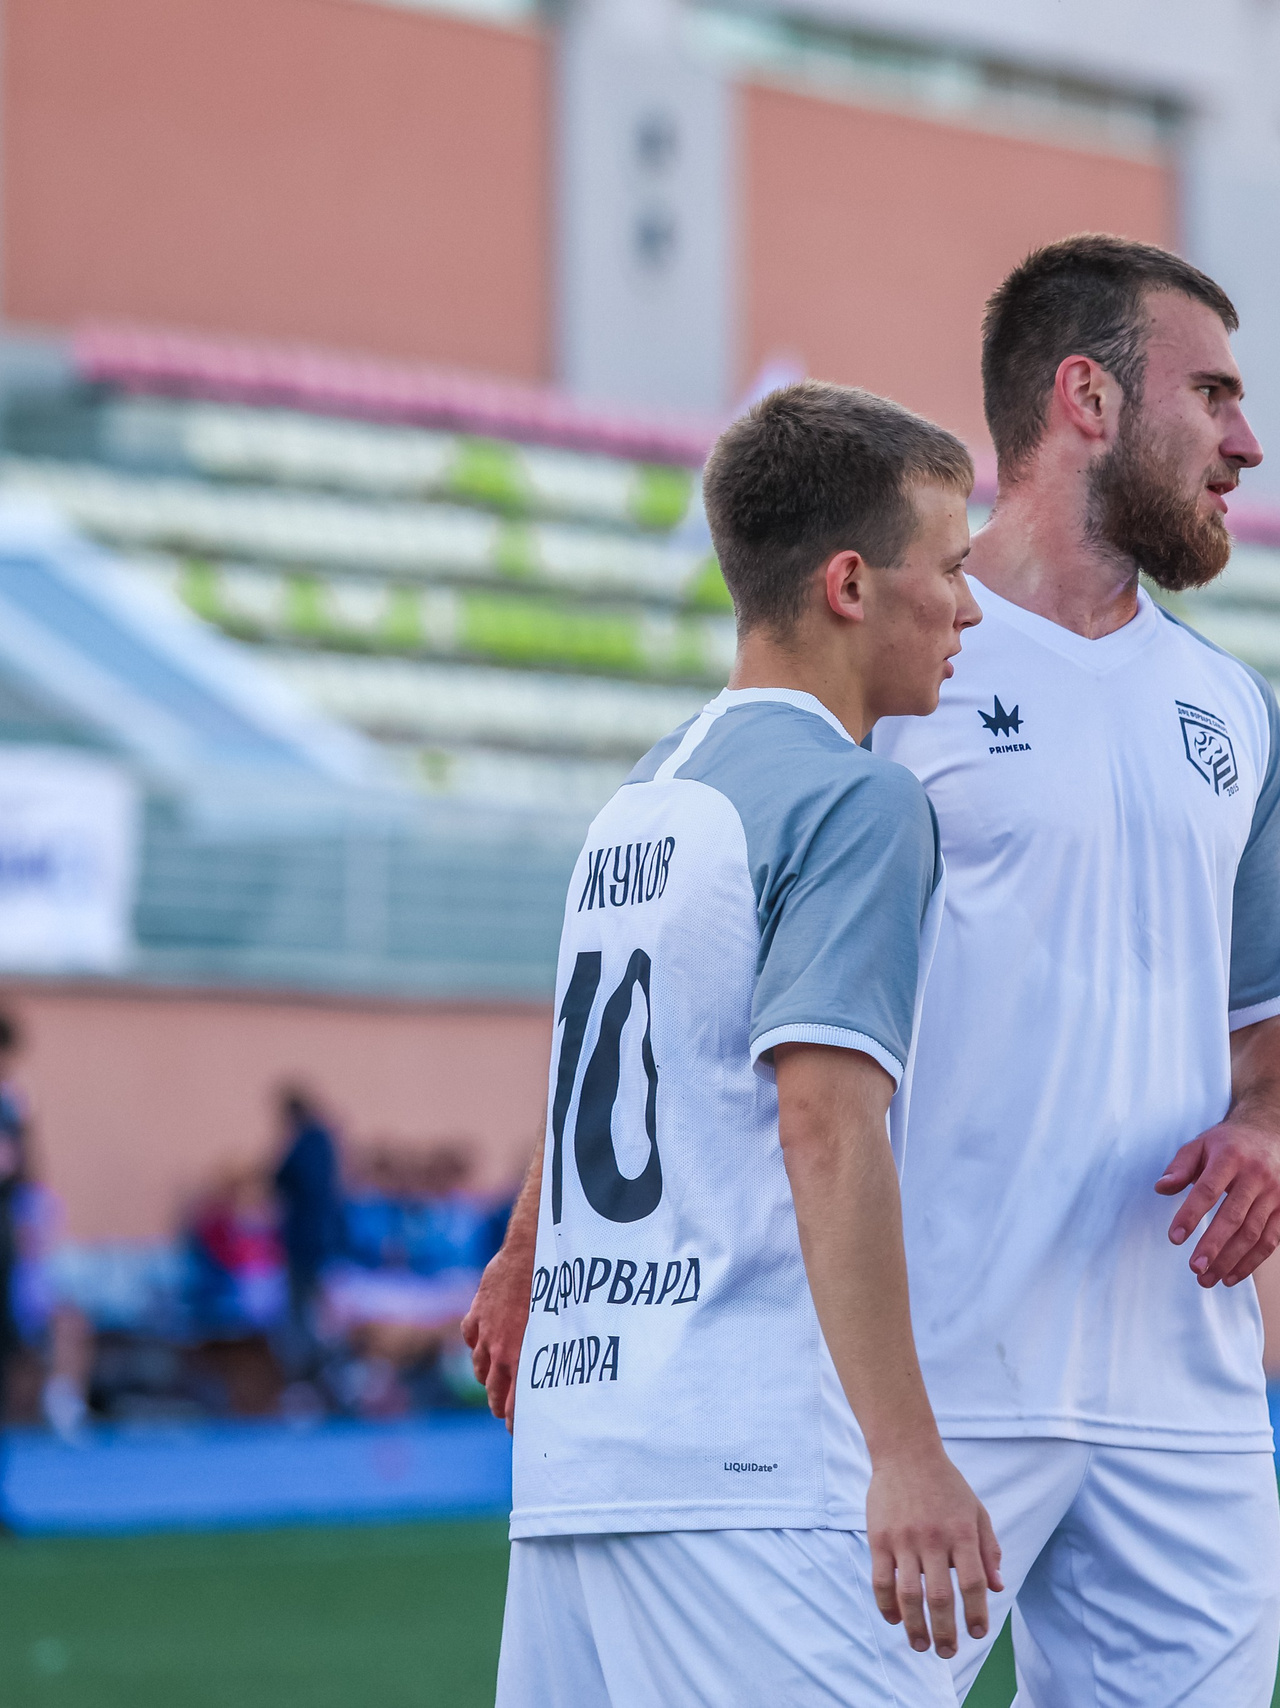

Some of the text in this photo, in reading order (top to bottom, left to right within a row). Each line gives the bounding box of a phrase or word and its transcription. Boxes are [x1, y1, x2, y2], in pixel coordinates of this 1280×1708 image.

[989, 743, 1031, 755] PRIMERA
[577, 836, 675, 913] ЖУКОВ
[551, 948, 663, 1225] 10
[559, 1257, 701, 1308] ФОРВАРД
[530, 1335, 620, 1389] САМАРА
